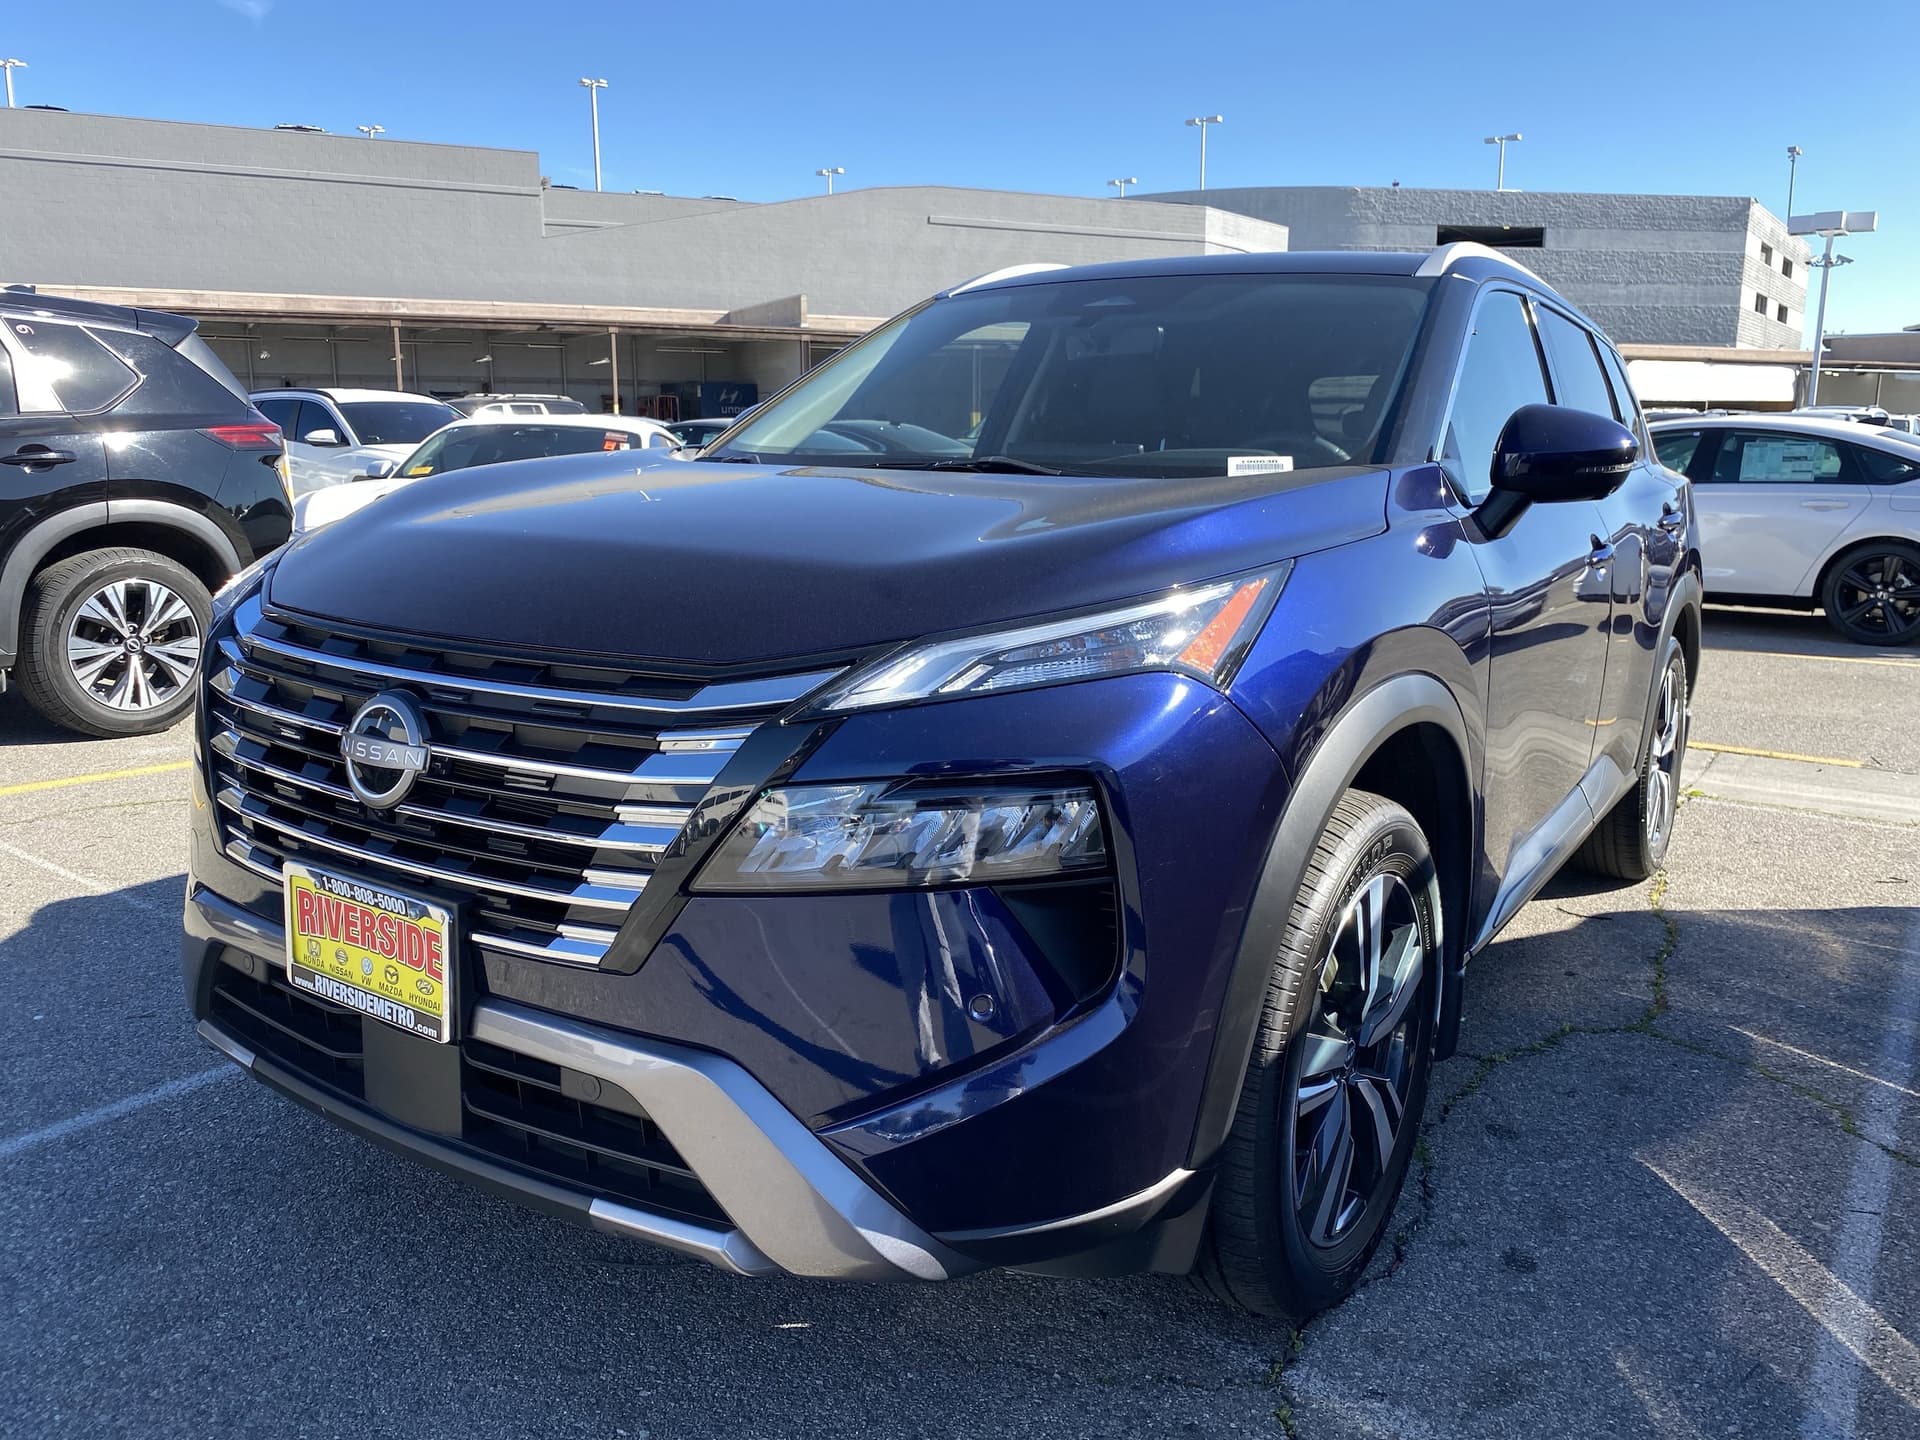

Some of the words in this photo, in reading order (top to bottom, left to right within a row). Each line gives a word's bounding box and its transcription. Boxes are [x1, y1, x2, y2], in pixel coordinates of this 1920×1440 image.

[341, 735, 421, 766] NISSAN
[322, 876, 406, 915] 1-800-808-5000
[296, 887, 443, 984] RIVERSIDE
[294, 974, 438, 1038] www.RIVERSIDEMETRO.com
[303, 953, 325, 969] HONDA
[329, 963, 354, 980] NISSAN
[361, 975, 372, 986] VW
[379, 981, 403, 998] MAZDA
[409, 993, 440, 1011] HYUNDAI
